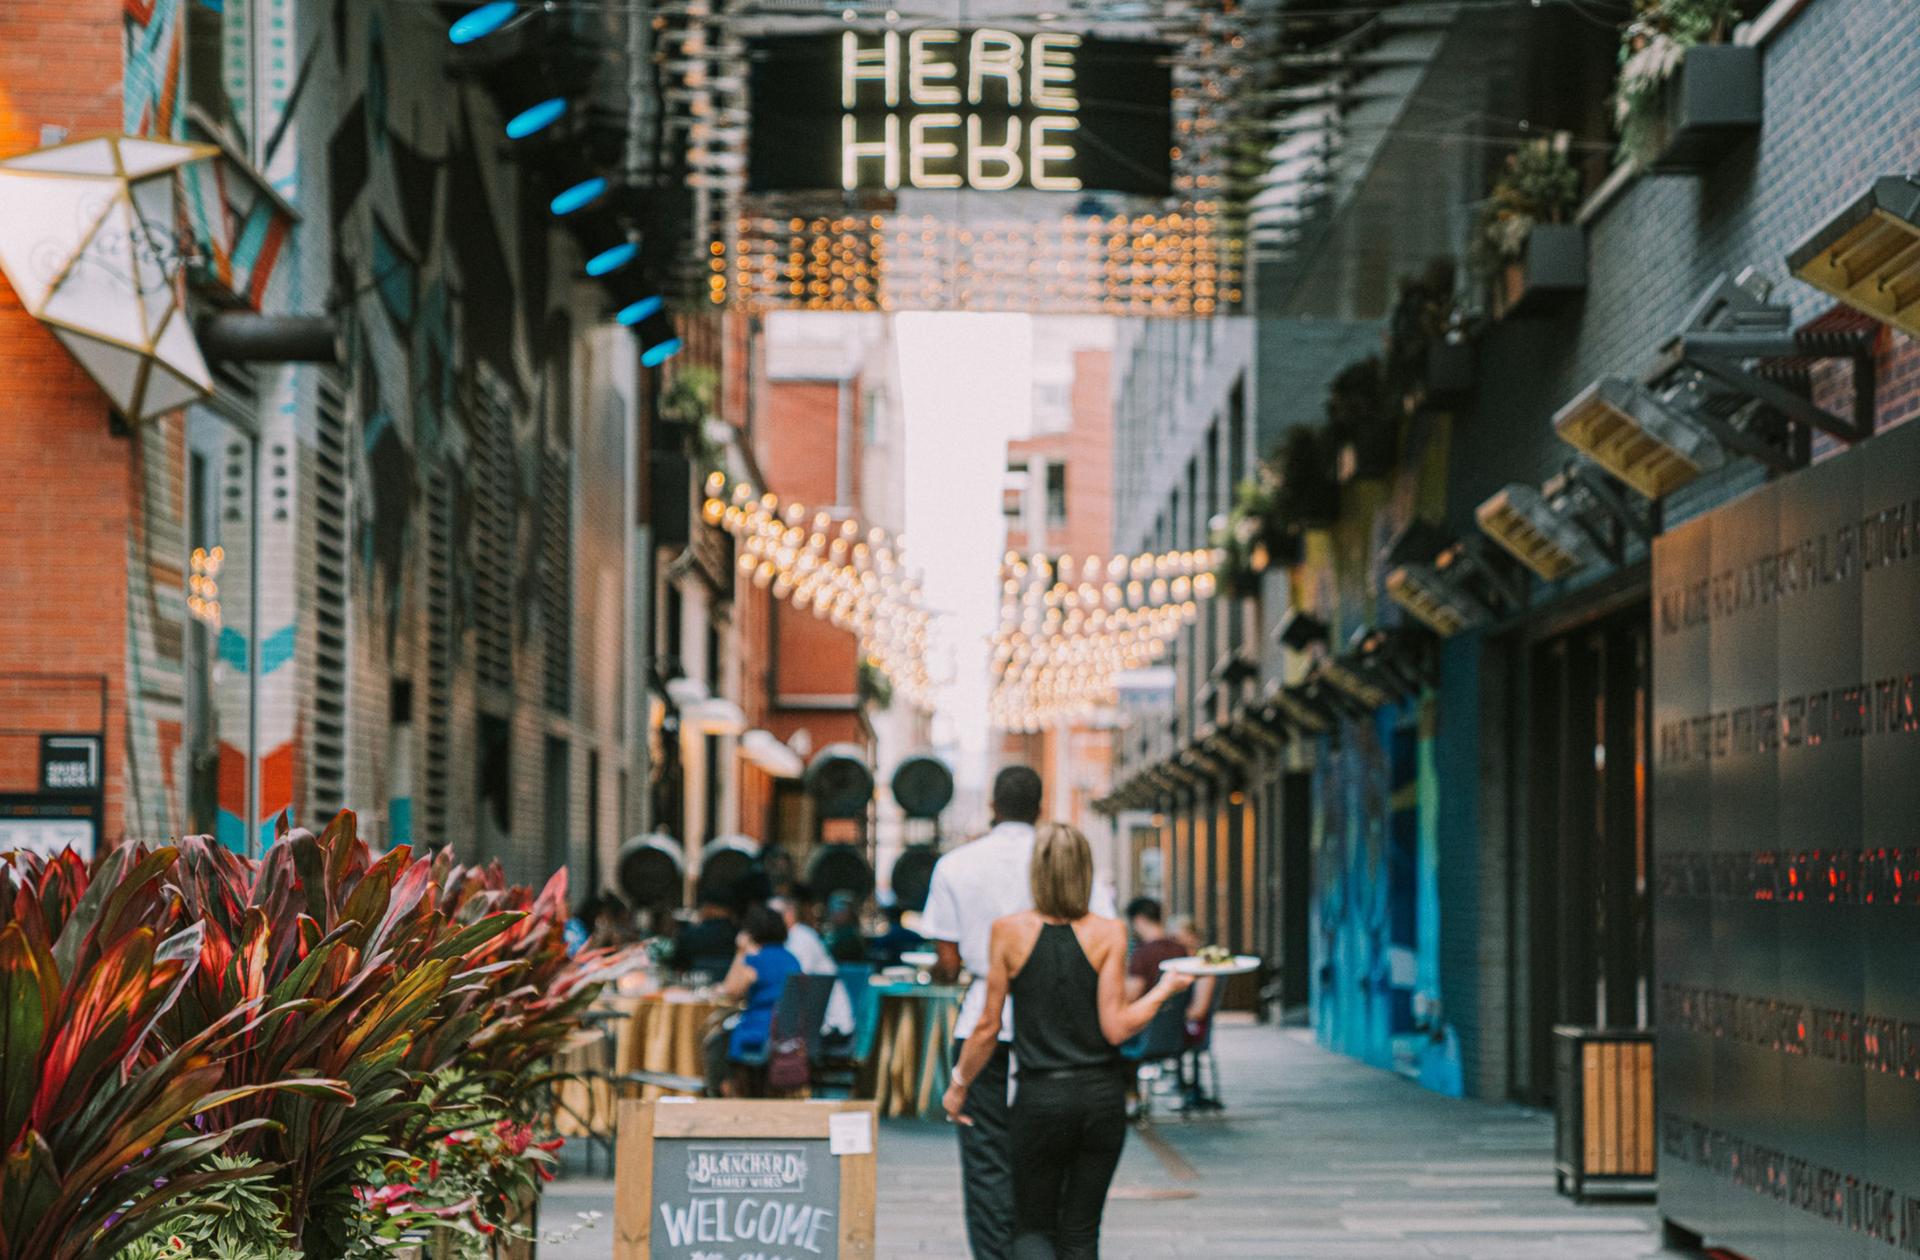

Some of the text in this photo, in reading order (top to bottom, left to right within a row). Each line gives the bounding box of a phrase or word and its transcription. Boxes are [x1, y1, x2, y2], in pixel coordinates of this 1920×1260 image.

[842, 29, 1082, 111] HERE
[695, 1152, 798, 1183] BLANCHARD
[660, 1198, 833, 1254] WELCOME
